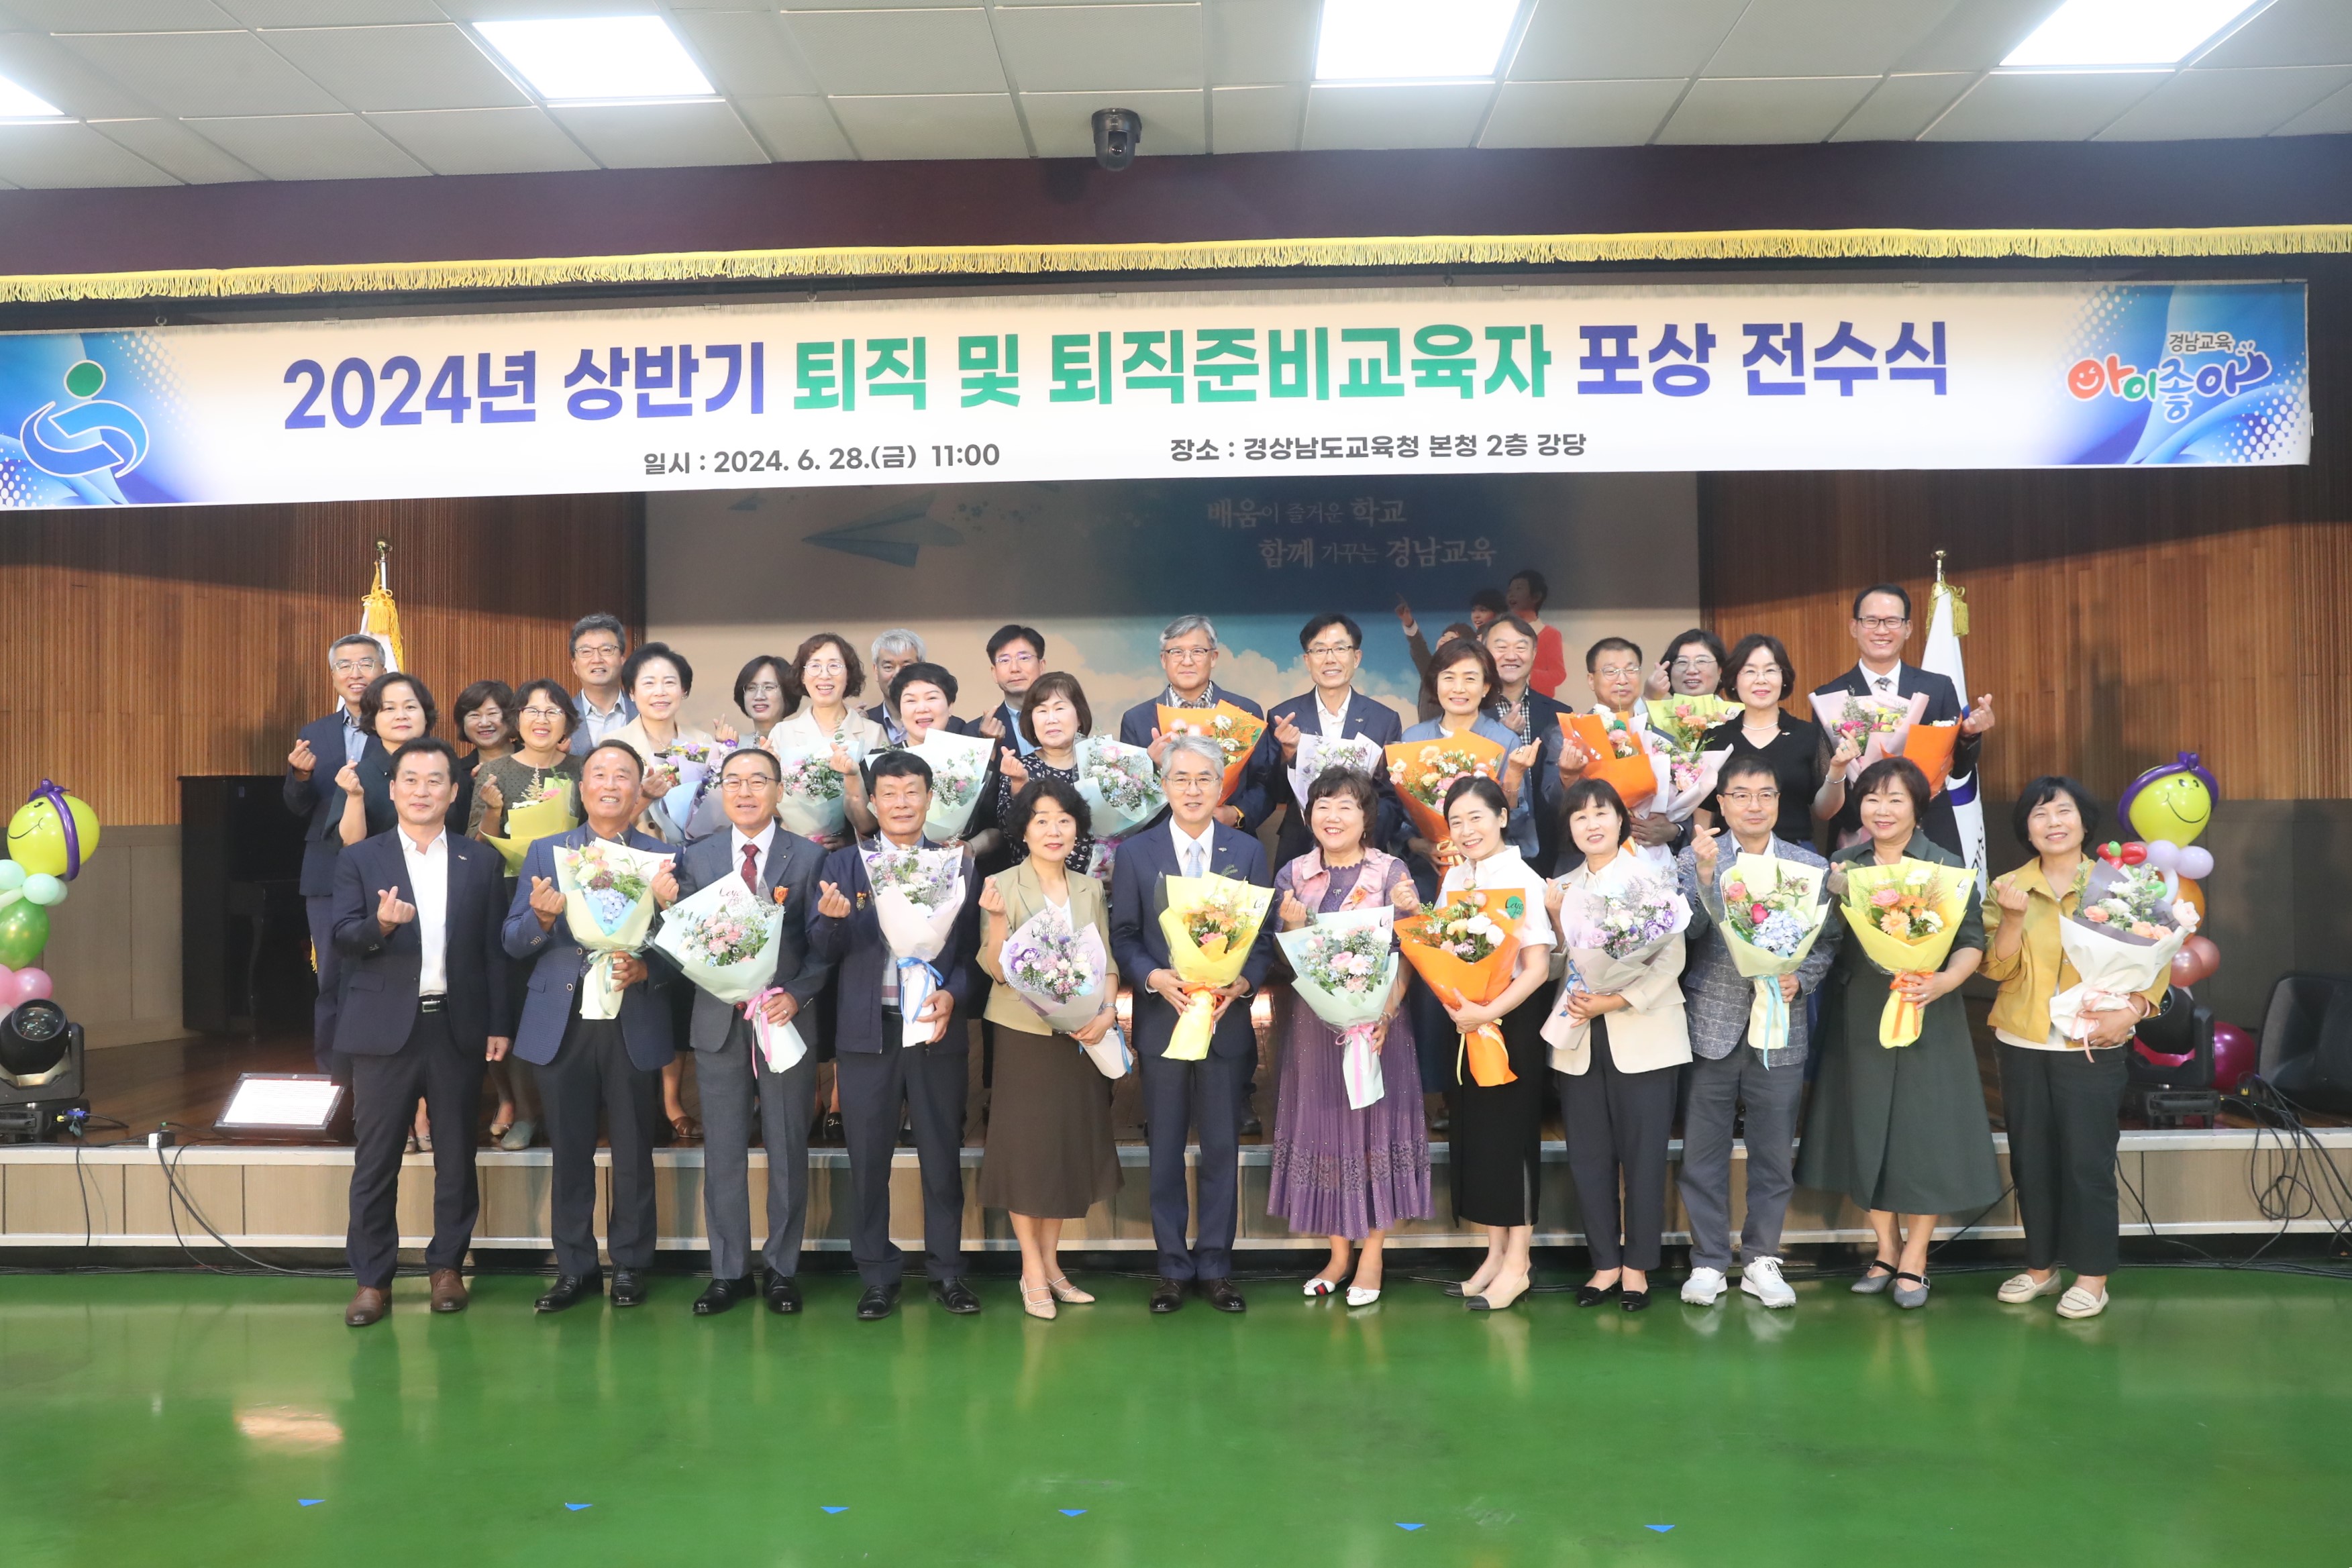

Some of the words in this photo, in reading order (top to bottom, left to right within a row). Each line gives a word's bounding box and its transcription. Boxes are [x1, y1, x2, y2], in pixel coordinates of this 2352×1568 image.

[2169, 333, 2235, 353] 경남교육
[285, 351, 536, 430] 2024년
[564, 342, 764, 421] 상반기
[794, 337, 927, 411] 퇴직
[958, 333, 1021, 409] 및
[1050, 323, 1553, 405] 퇴직준비교육자
[1577, 323, 1717, 397] 포상
[1743, 321, 1947, 397] 전수식
[2067, 351, 2272, 423] 아이좋아
[644, 452, 691, 476] 일시
[713, 450, 790, 474] 2024.
[797, 448, 821, 471] 6.
[931, 443, 1001, 468] 11:00
[1170, 438, 1220, 462] 장소
[1243, 435, 1420, 461] 경상남도교육청
[1429, 433, 1478, 458] 본청
[1486, 433, 1528, 458] 2층
[1537, 433, 1587, 457] 강당
[1206, 497, 1279, 529] 배움이
[1284, 501, 1345, 524] 즐거운
[1349, 495, 1408, 528] 학교
[1257, 537, 1314, 570] 함께
[1320, 541, 1380, 565] 가꾸는
[1385, 535, 1497, 569] 경남교육
